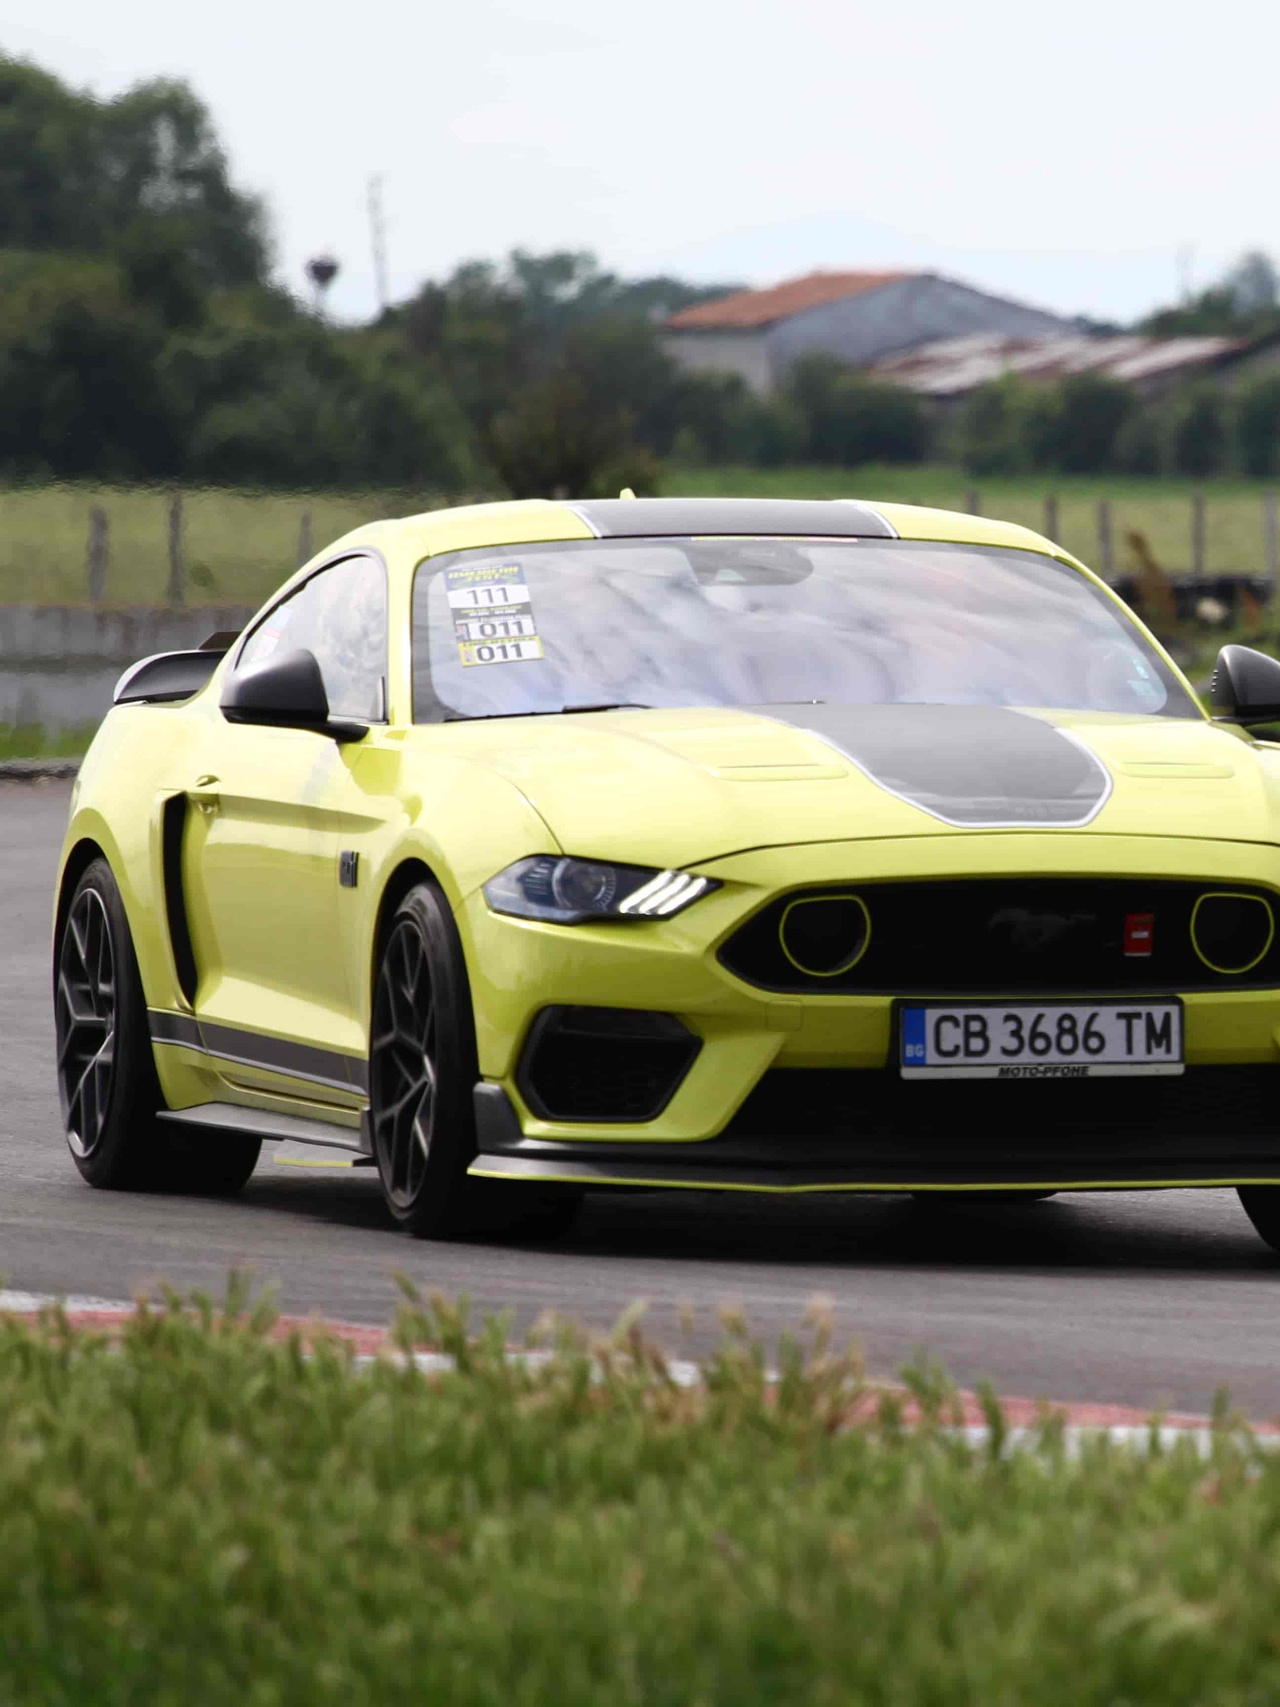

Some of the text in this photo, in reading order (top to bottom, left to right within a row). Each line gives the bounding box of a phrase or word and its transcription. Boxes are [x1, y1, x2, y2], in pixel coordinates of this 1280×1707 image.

[467, 587, 509, 605] 111
[479, 620, 523, 637] 011
[477, 643, 522, 662] 011
[933, 1011, 1172, 1057] CB 3686 TM
[905, 1044, 924, 1058] BG
